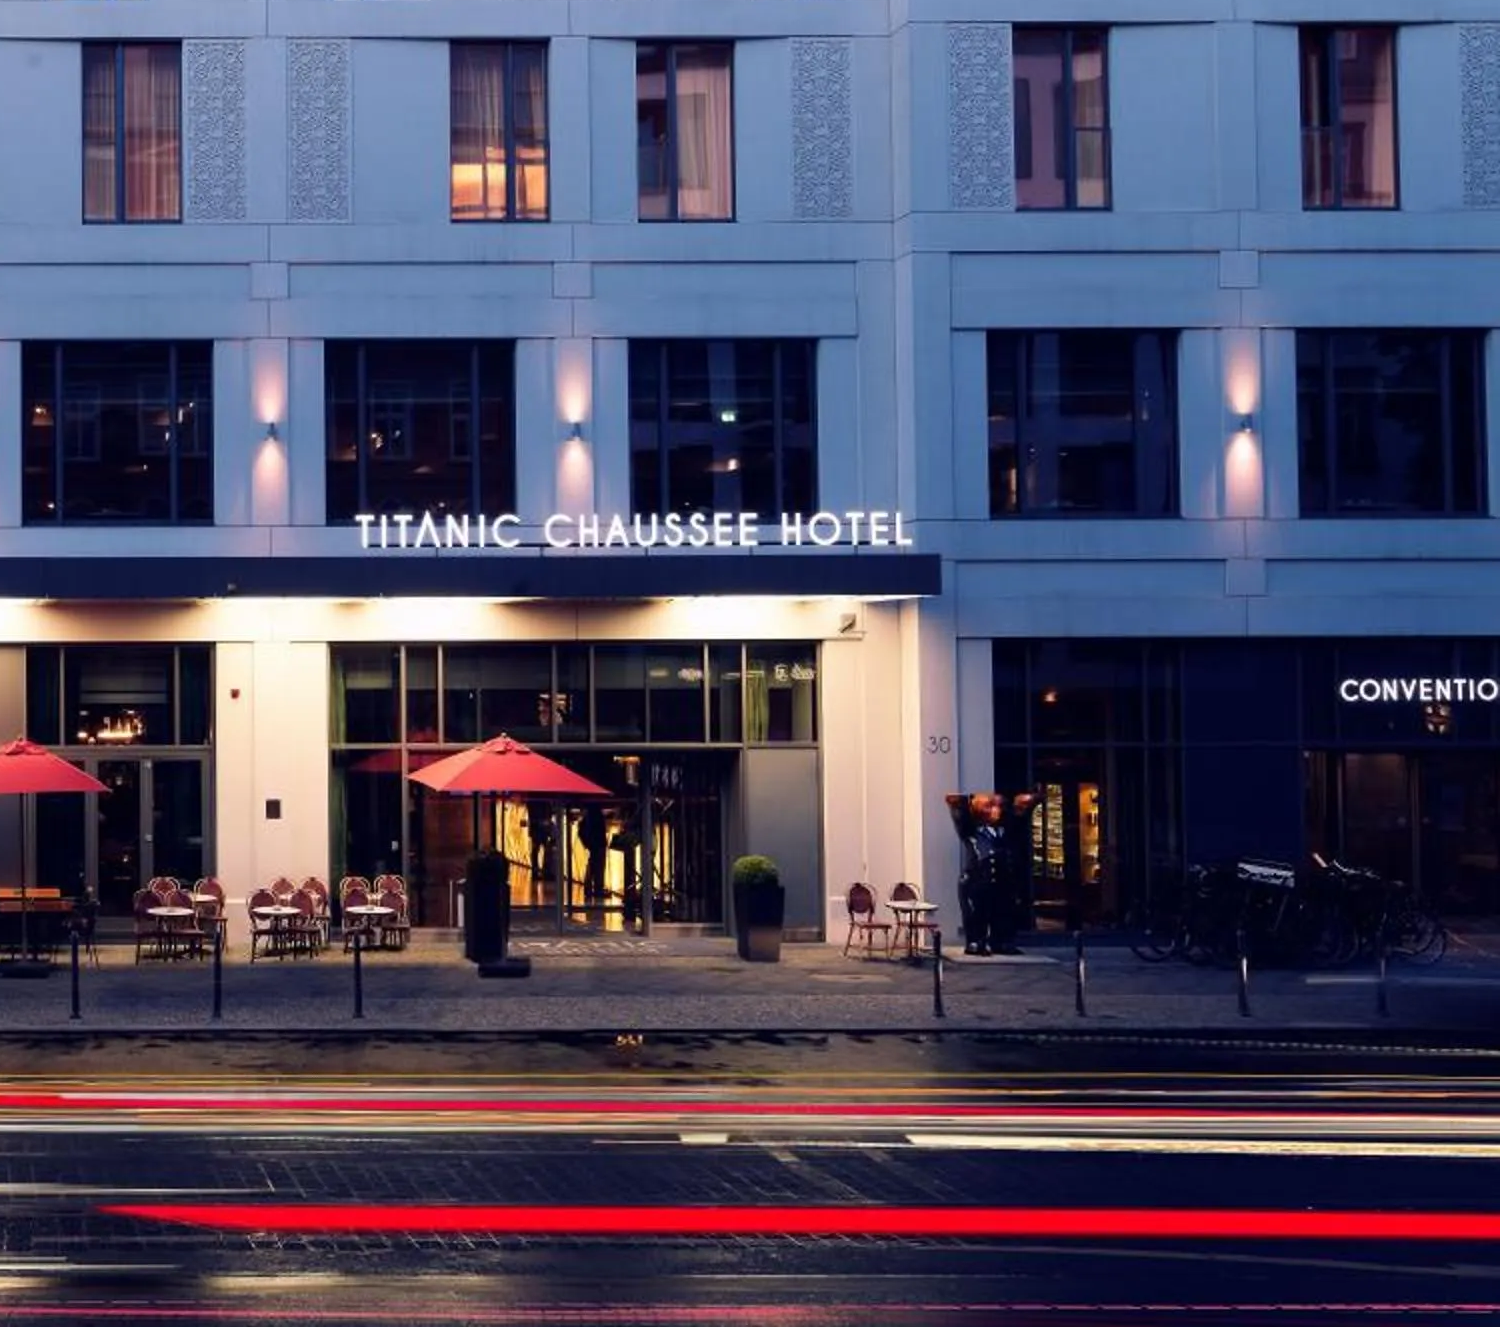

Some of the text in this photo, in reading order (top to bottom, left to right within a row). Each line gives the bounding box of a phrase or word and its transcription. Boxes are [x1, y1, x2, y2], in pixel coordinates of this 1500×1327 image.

[355, 511, 913, 548] TITANIC CHAUSSEE HOTEL
[1340, 678, 1498, 702] CONVENTIO
[927, 735, 951, 754] 30
